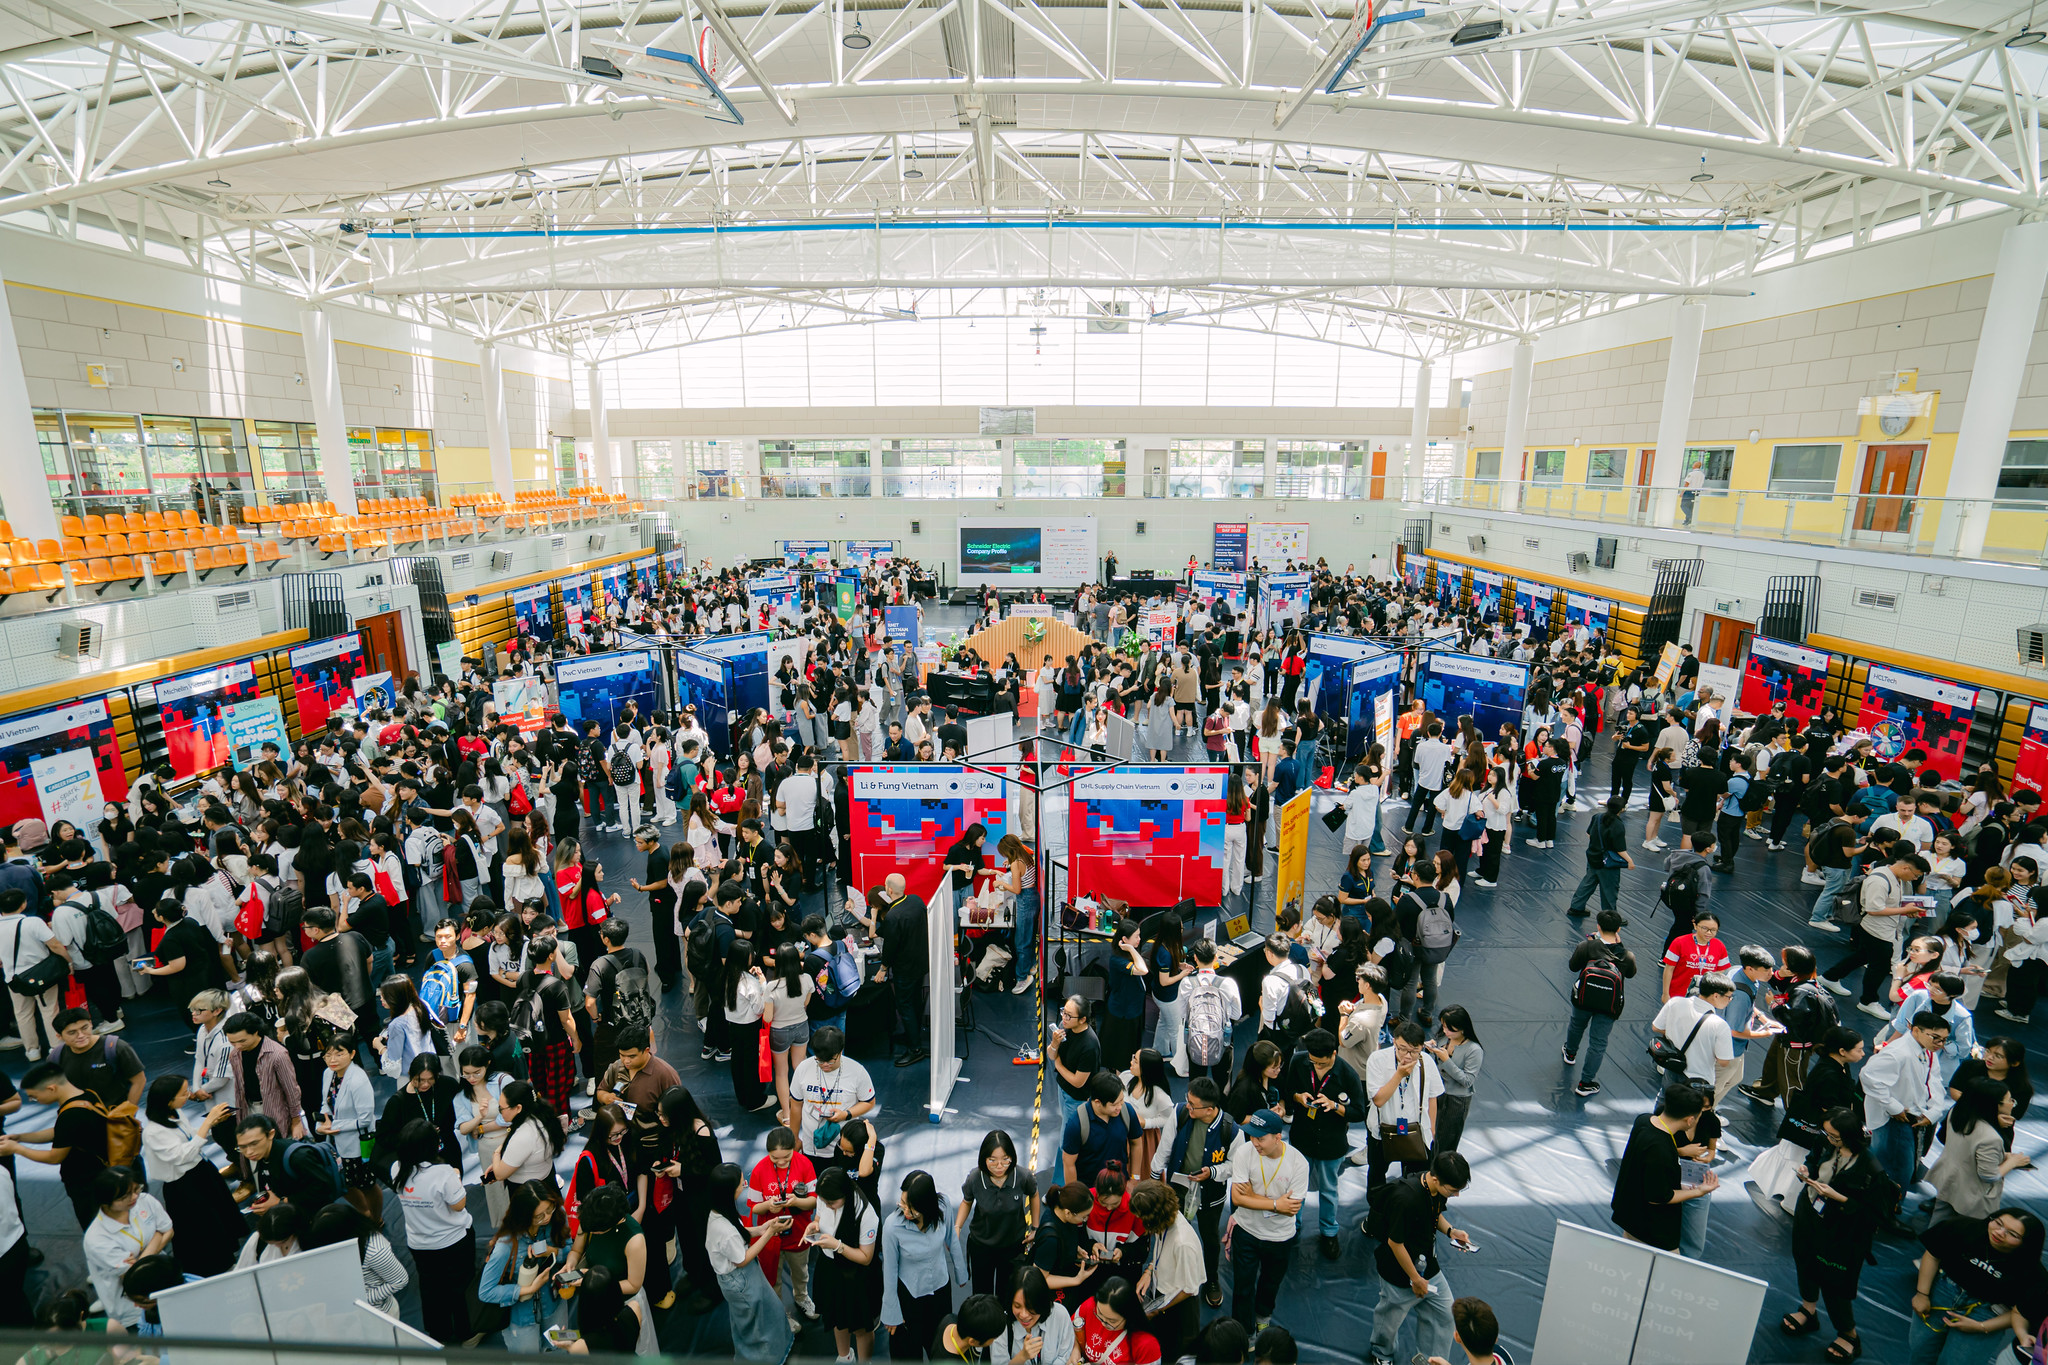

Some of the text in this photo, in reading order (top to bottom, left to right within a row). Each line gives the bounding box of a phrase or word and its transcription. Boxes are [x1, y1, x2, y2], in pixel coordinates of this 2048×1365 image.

[1314, 642, 1328, 650] ACFC
[577, 666, 602, 674] Vietnam
[1434, 660, 1454, 671] Shopee
[1455, 664, 1482, 674] Vietnam
[1873, 674, 1898, 685] HCLTech
[164, 684, 189, 696] Michelin
[189, 679, 212, 690] Vietnam
[6, 725, 40, 738] Vietnam
[60, 785, 80, 802] spark
[80, 779, 96, 801] Z
[860, 782, 868, 790] Li
[870, 782, 876, 790] &
[878, 782, 900, 792] Fung
[902, 782, 939, 790] Vietnam
[1094, 783, 1114, 791] Supply
[63, 795, 79, 812] your
